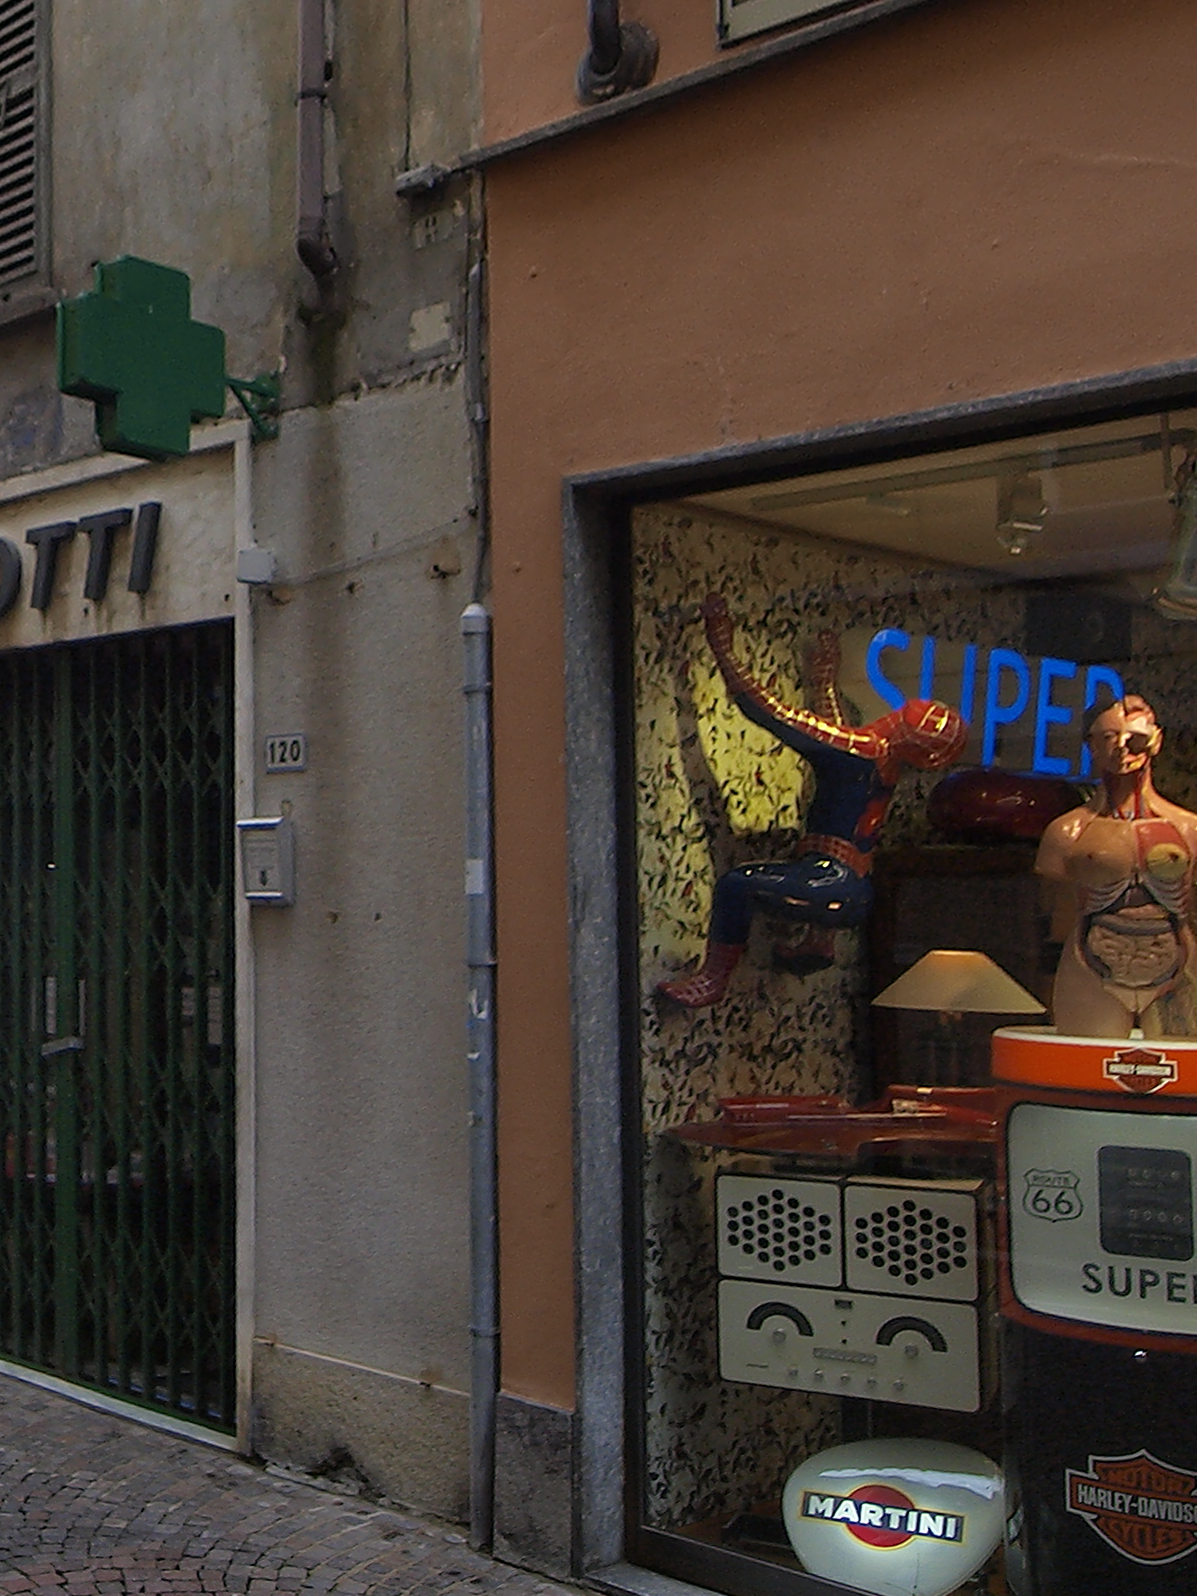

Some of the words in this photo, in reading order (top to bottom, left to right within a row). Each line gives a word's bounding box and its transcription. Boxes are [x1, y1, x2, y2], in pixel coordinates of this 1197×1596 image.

[270, 739, 301, 764] 120
[1032, 1189, 1073, 1215] 66
[1082, 1262, 1197, 1304] SUPE
[807, 1494, 957, 1538] MARTINI
[1077, 1483, 1197, 1523] HARLEY-DAVIDS
